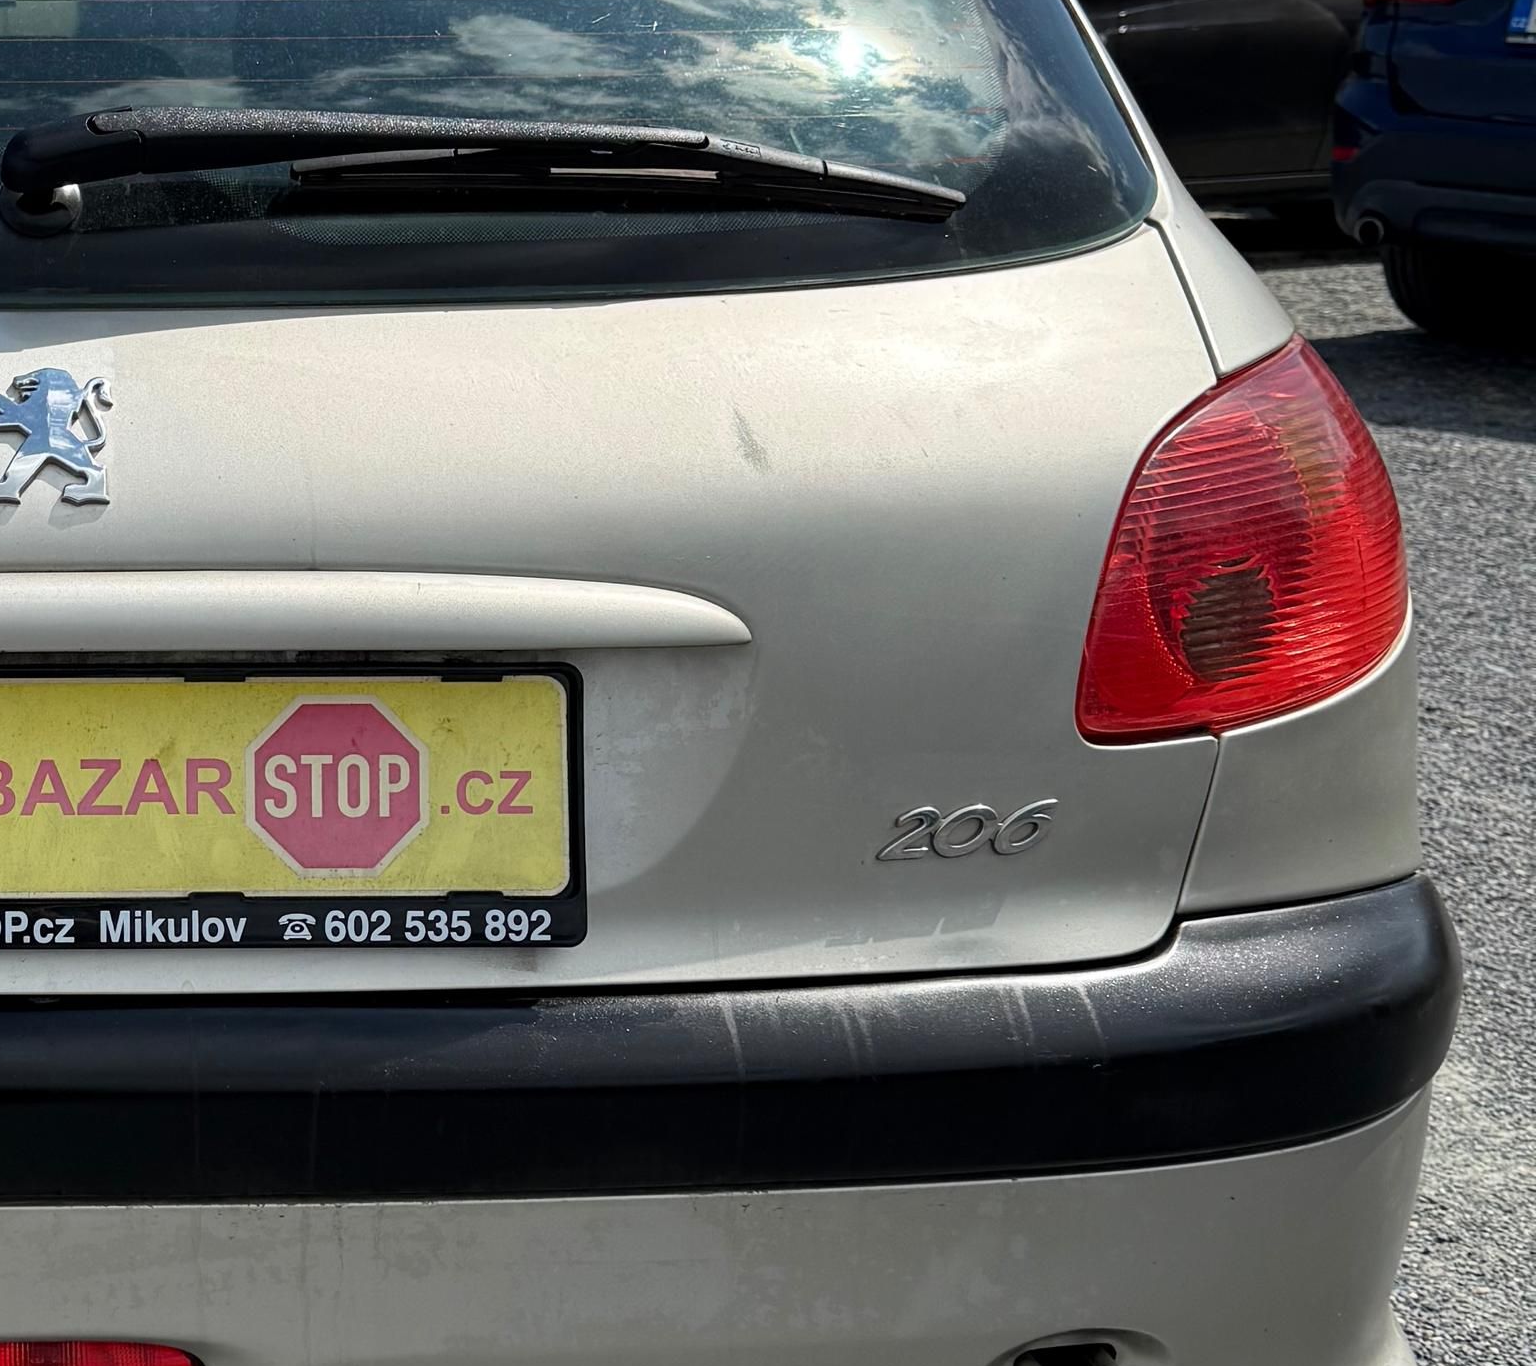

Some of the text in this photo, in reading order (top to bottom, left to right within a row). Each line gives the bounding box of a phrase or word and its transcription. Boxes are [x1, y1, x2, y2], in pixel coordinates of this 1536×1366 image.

[263, 753, 411, 819] STOP
[876, 797, 1059, 862] 206
[99, 909, 248, 944] Mikulov
[323, 909, 393, 943] 602
[403, 909, 472, 943] 535
[484, 909, 553, 943] 892
